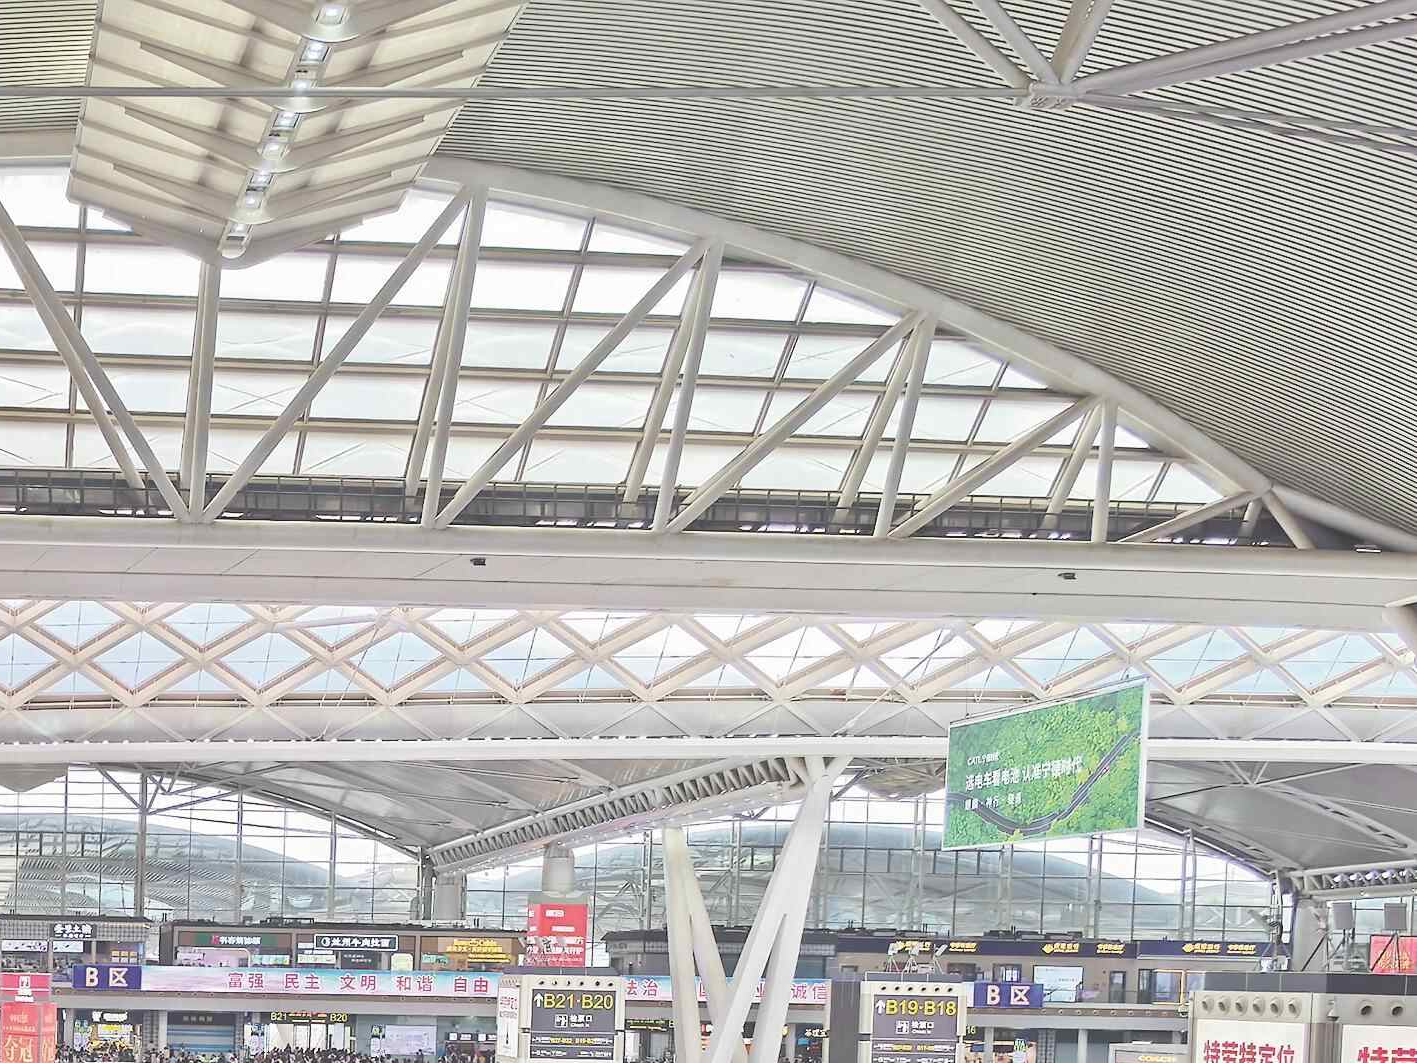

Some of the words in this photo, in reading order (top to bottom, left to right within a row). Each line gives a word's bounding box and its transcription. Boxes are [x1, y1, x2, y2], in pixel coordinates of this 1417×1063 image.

[85, 966, 99, 987] B
[108, 967, 128, 987] 区
[228, 972, 264, 989] 富强
[284, 973, 320, 990] 民主
[339, 975, 377, 991] 文明
[396, 975, 433, 992] 和谐
[454, 978, 489, 993] 自由
[791, 983, 828, 1000] 诚信
[544, 992, 614, 1009] B21·B20
[987, 985, 1000, 1005] B
[1010, 985, 1030, 1005] 区
[885, 999, 957, 1016] B19·B18
[4, 1035, 33, 1063] 夺冠
